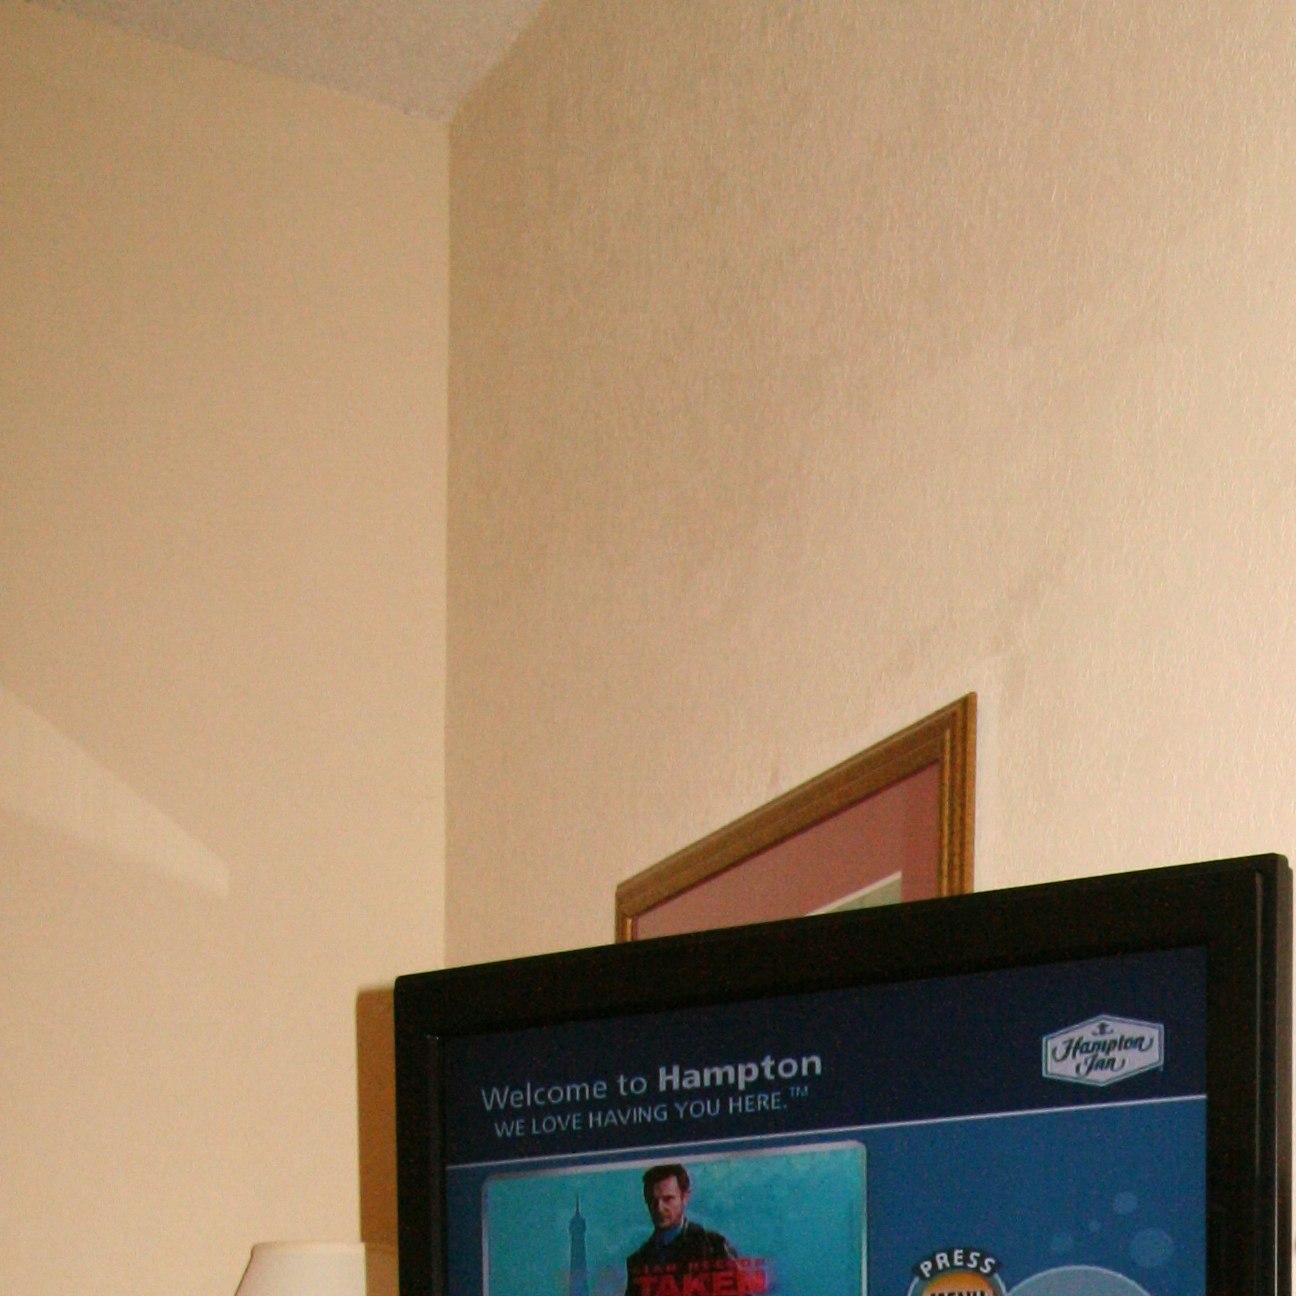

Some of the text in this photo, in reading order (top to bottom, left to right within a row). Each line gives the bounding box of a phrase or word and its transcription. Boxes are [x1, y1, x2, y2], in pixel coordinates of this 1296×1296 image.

[1052, 1033, 1154, 1063] Hampton
[480, 1053, 823, 1113] Welcome to Hampton
[494, 1119, 525, 1139] WE
[531, 1113, 582, 1136] LOVE
[588, 1103, 669, 1129] HAVING
[674, 1097, 721, 1119] YOU
[919, 1248, 997, 1279] PRESS
